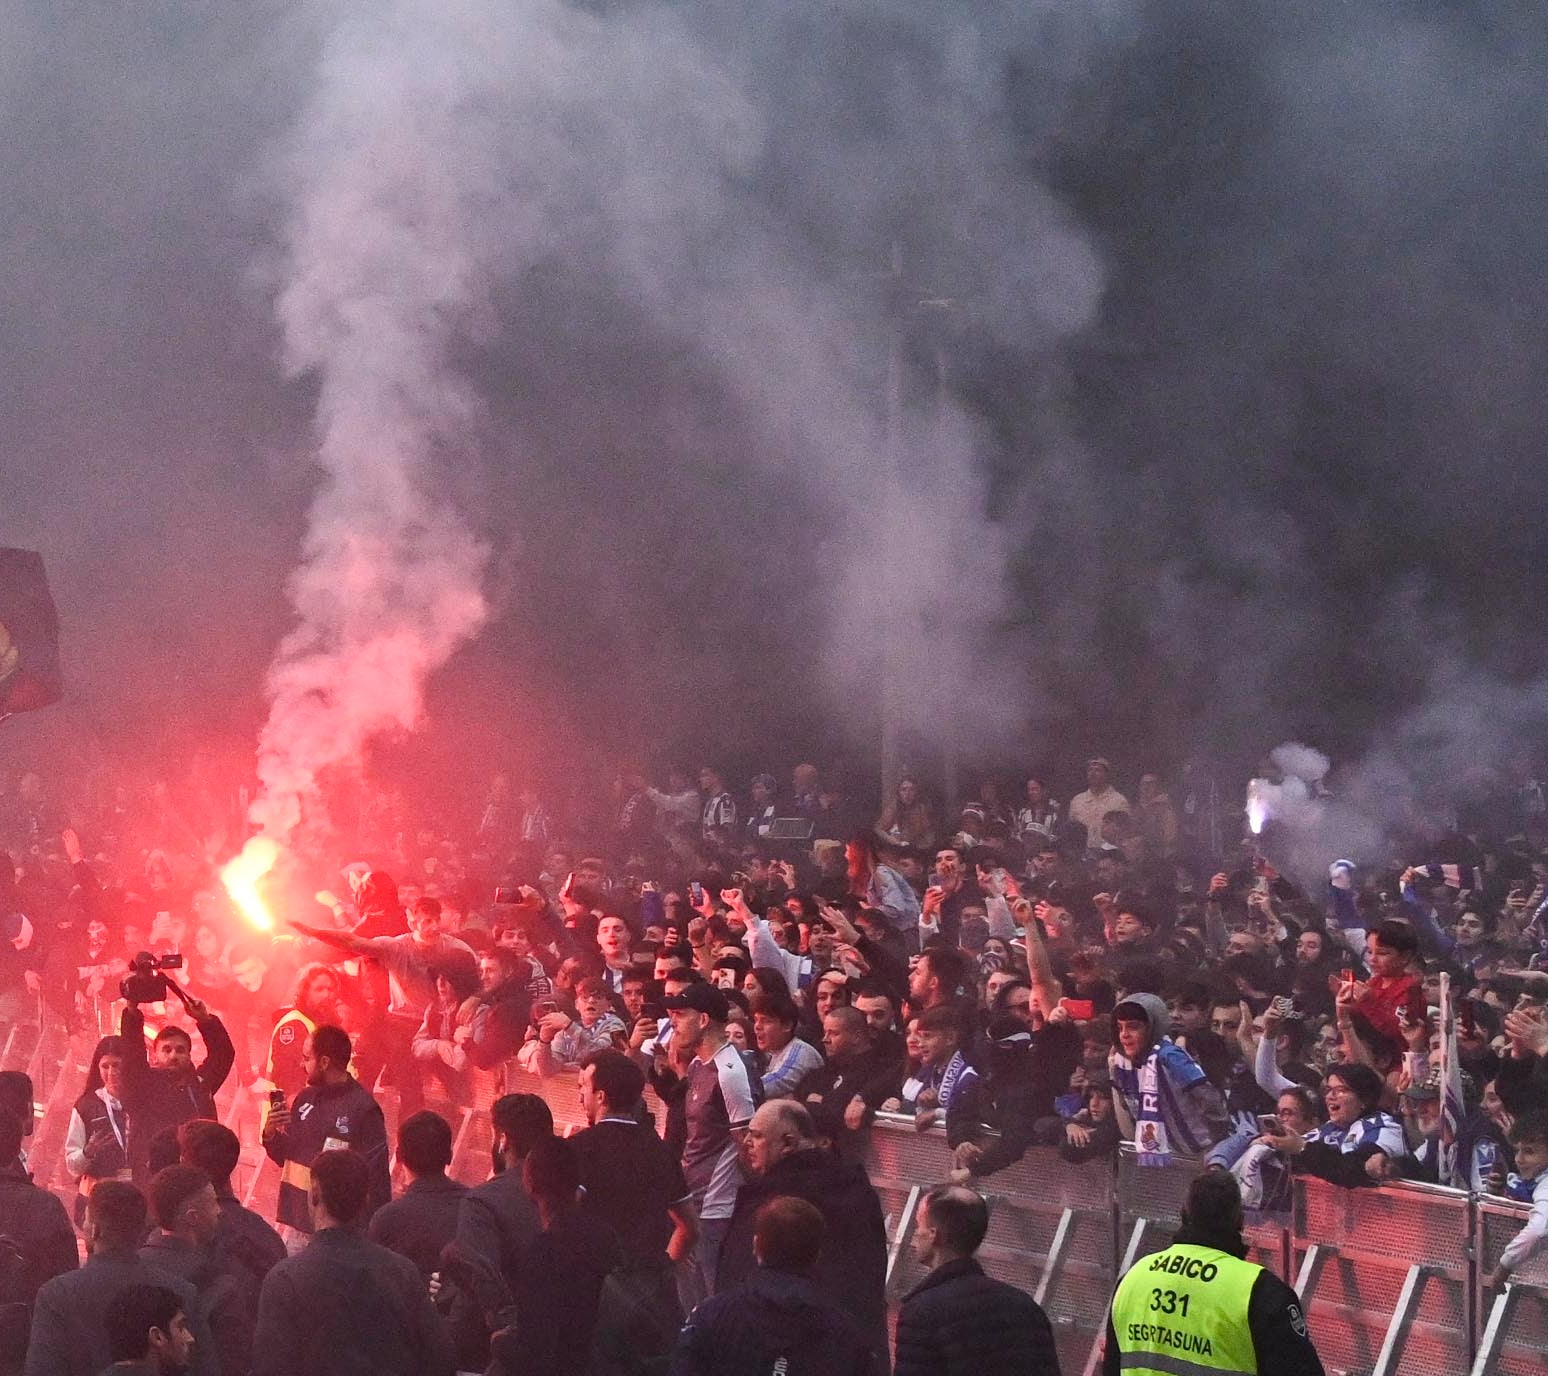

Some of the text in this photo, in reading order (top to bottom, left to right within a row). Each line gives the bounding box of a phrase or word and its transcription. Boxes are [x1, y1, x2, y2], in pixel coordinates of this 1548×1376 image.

[1149, 1255, 1219, 1283] SABICO
[1150, 1288, 1190, 1318] 331
[1128, 1323, 1213, 1357] SEGRTASUNA
